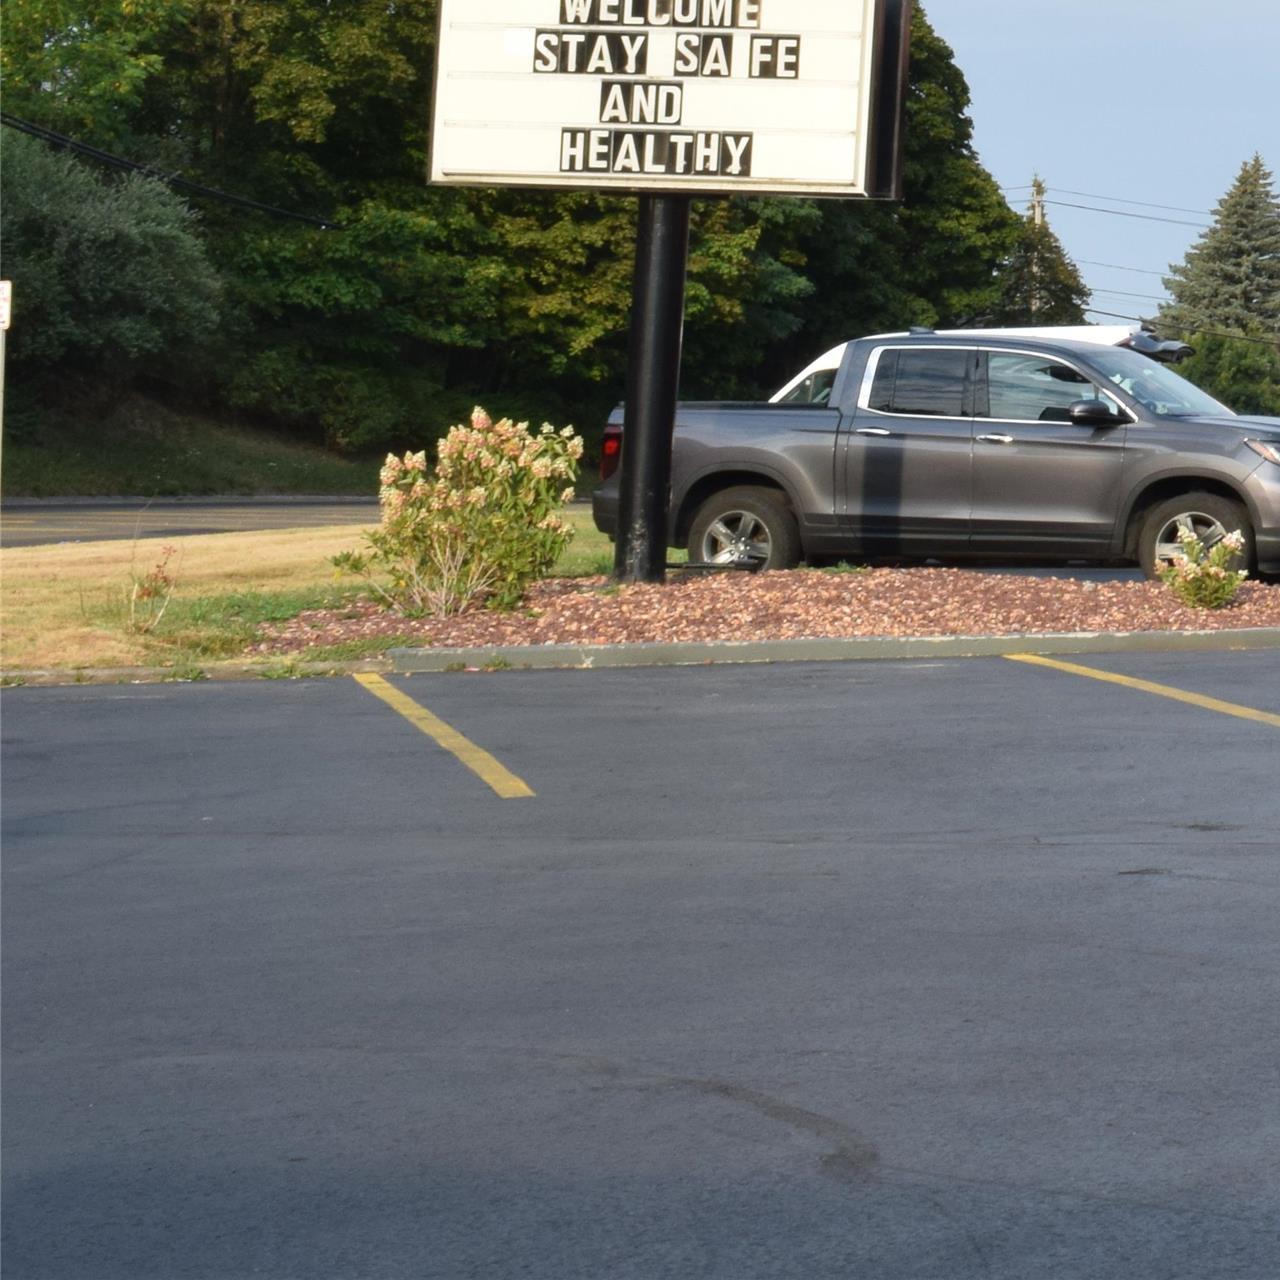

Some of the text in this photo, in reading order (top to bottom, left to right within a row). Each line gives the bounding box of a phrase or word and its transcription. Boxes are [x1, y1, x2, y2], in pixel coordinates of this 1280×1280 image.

[534, 33, 646, 74] STAY
[601, 84, 682, 124] AND
[561, 131, 750, 175] HEALTHY
